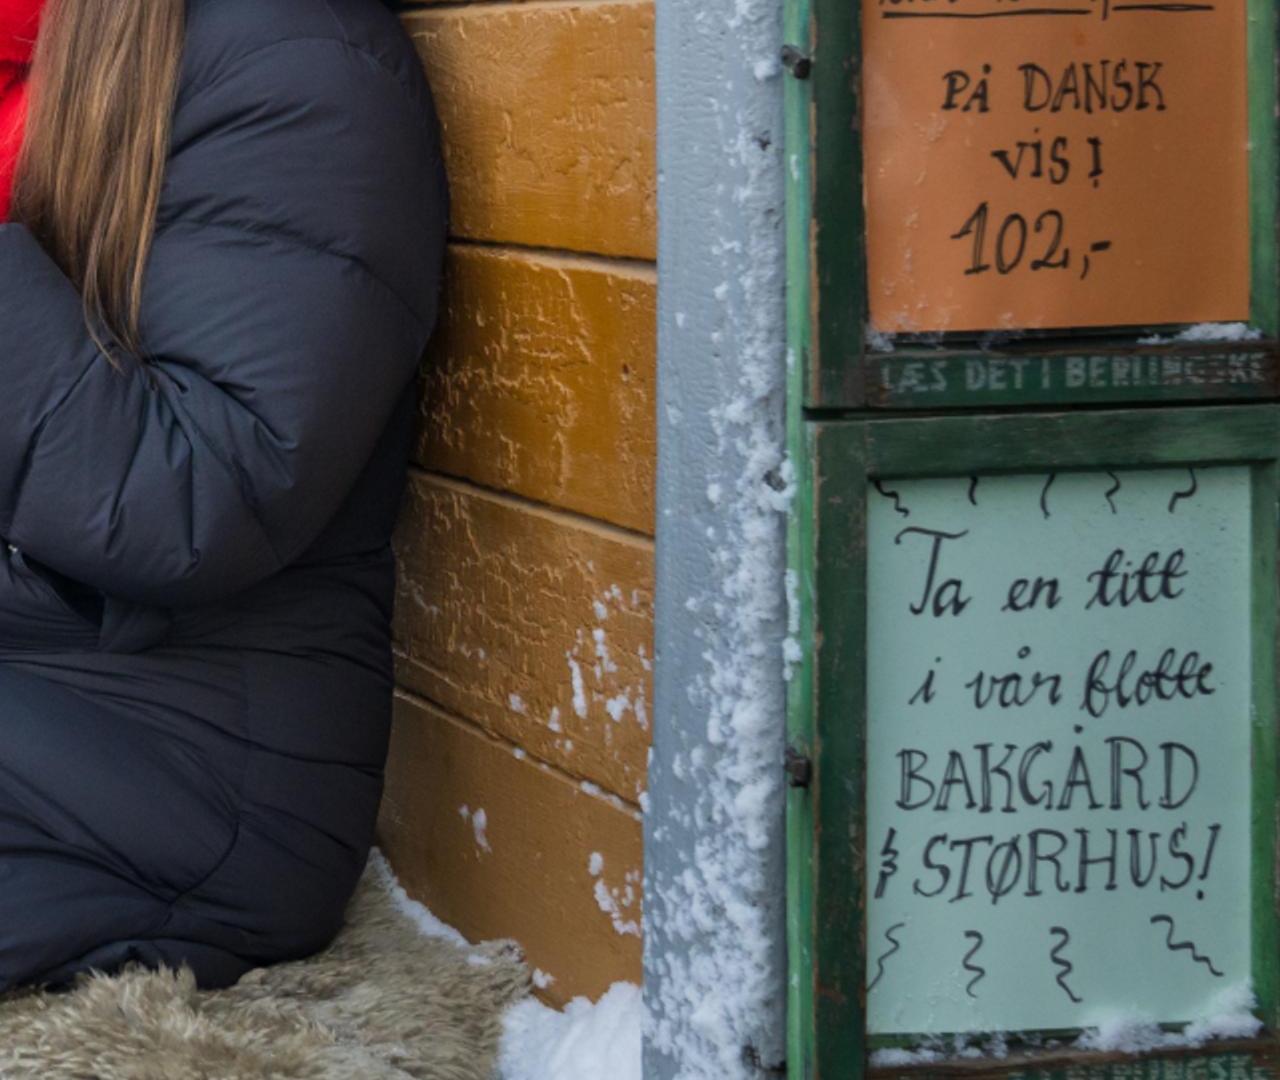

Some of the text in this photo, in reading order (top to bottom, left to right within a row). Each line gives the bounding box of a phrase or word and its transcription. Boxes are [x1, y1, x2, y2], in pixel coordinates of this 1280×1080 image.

[941, 58, 1167, 114] PÅ DANSK
[950, 201, 1112, 281] 102,-
[881, 359, 948, 392] LÆS
[965, 357, 1031, 390] DET
[1042, 358, 1051, 388] I
[895, 526, 1188, 617] Ta en titt
[908, 645, 1216, 718] i vår flotte
[895, 724, 1200, 813] BAKGÅRD
[913, 821, 1222, 906] STØRHUS!
